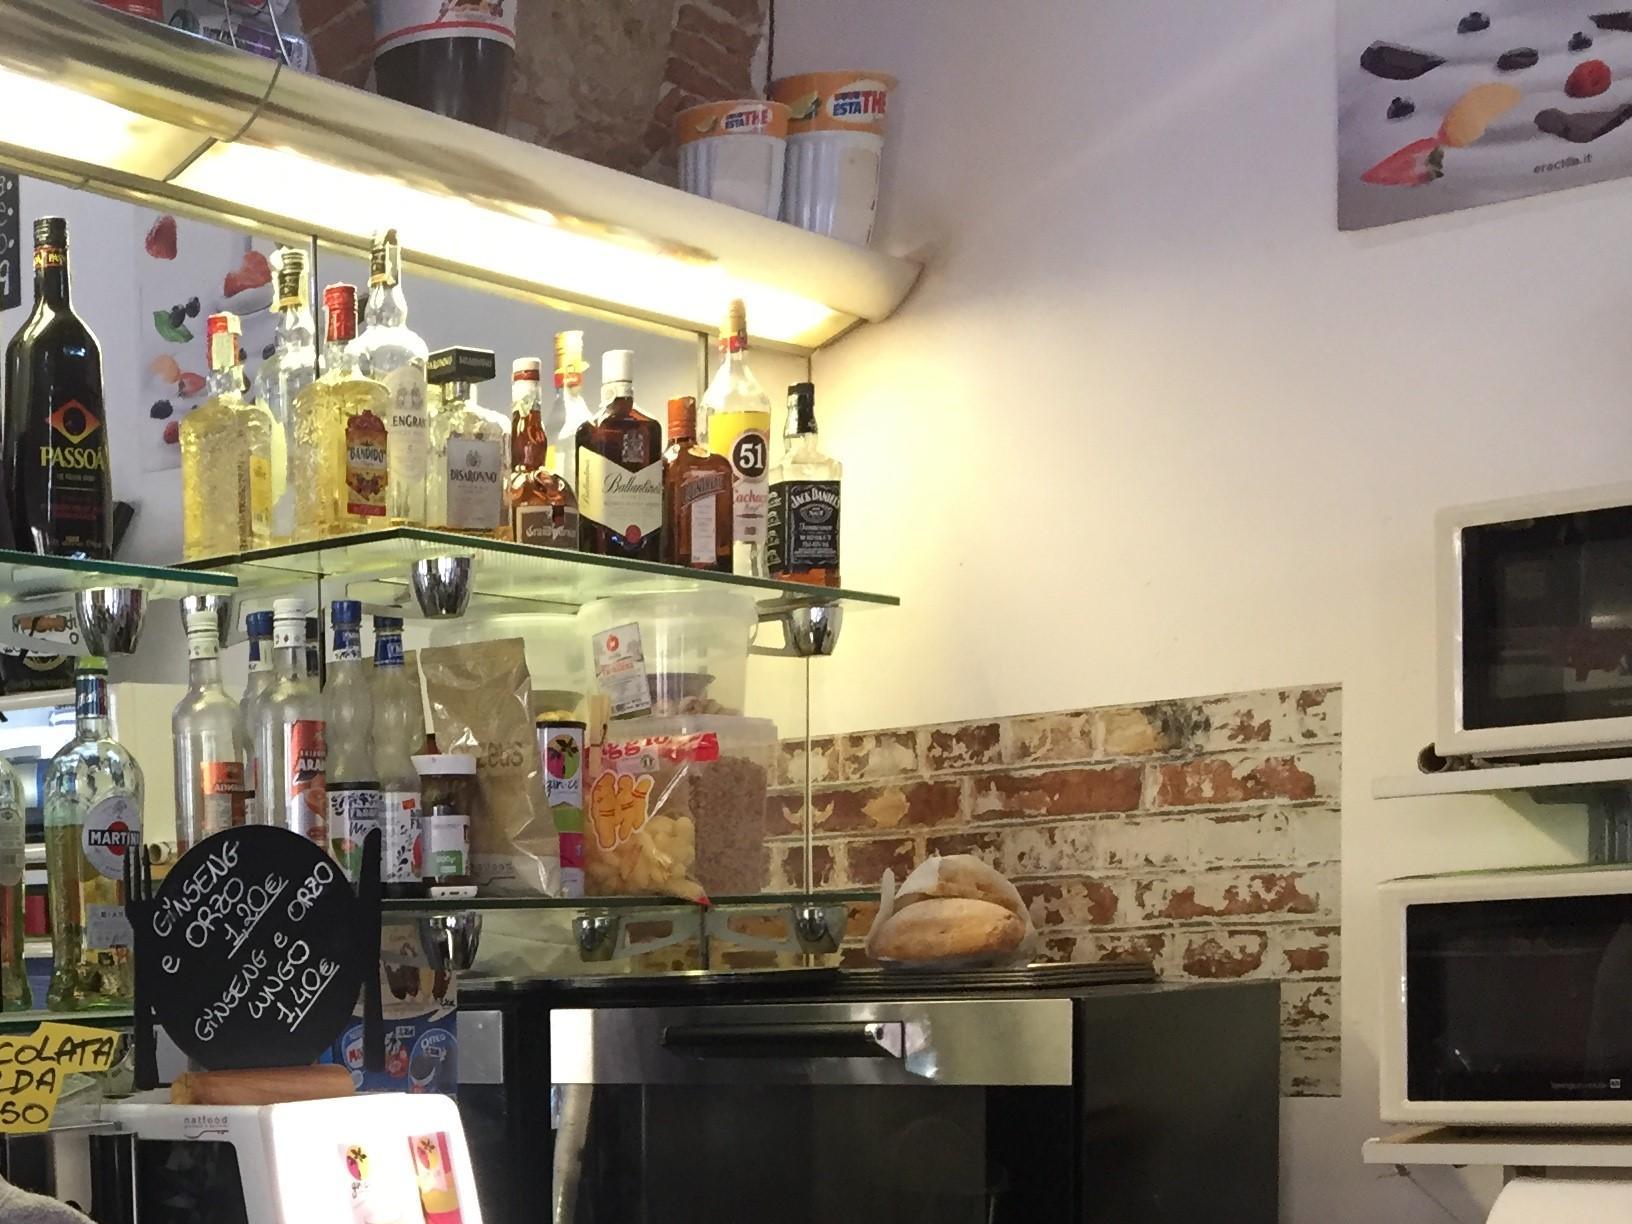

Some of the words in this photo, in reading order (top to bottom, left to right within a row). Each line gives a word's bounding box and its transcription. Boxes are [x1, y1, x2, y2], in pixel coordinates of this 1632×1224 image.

[739, 442, 764, 469] 51
[186, 877, 244, 948] ORZO
[287, 861, 334, 922] ORZO
